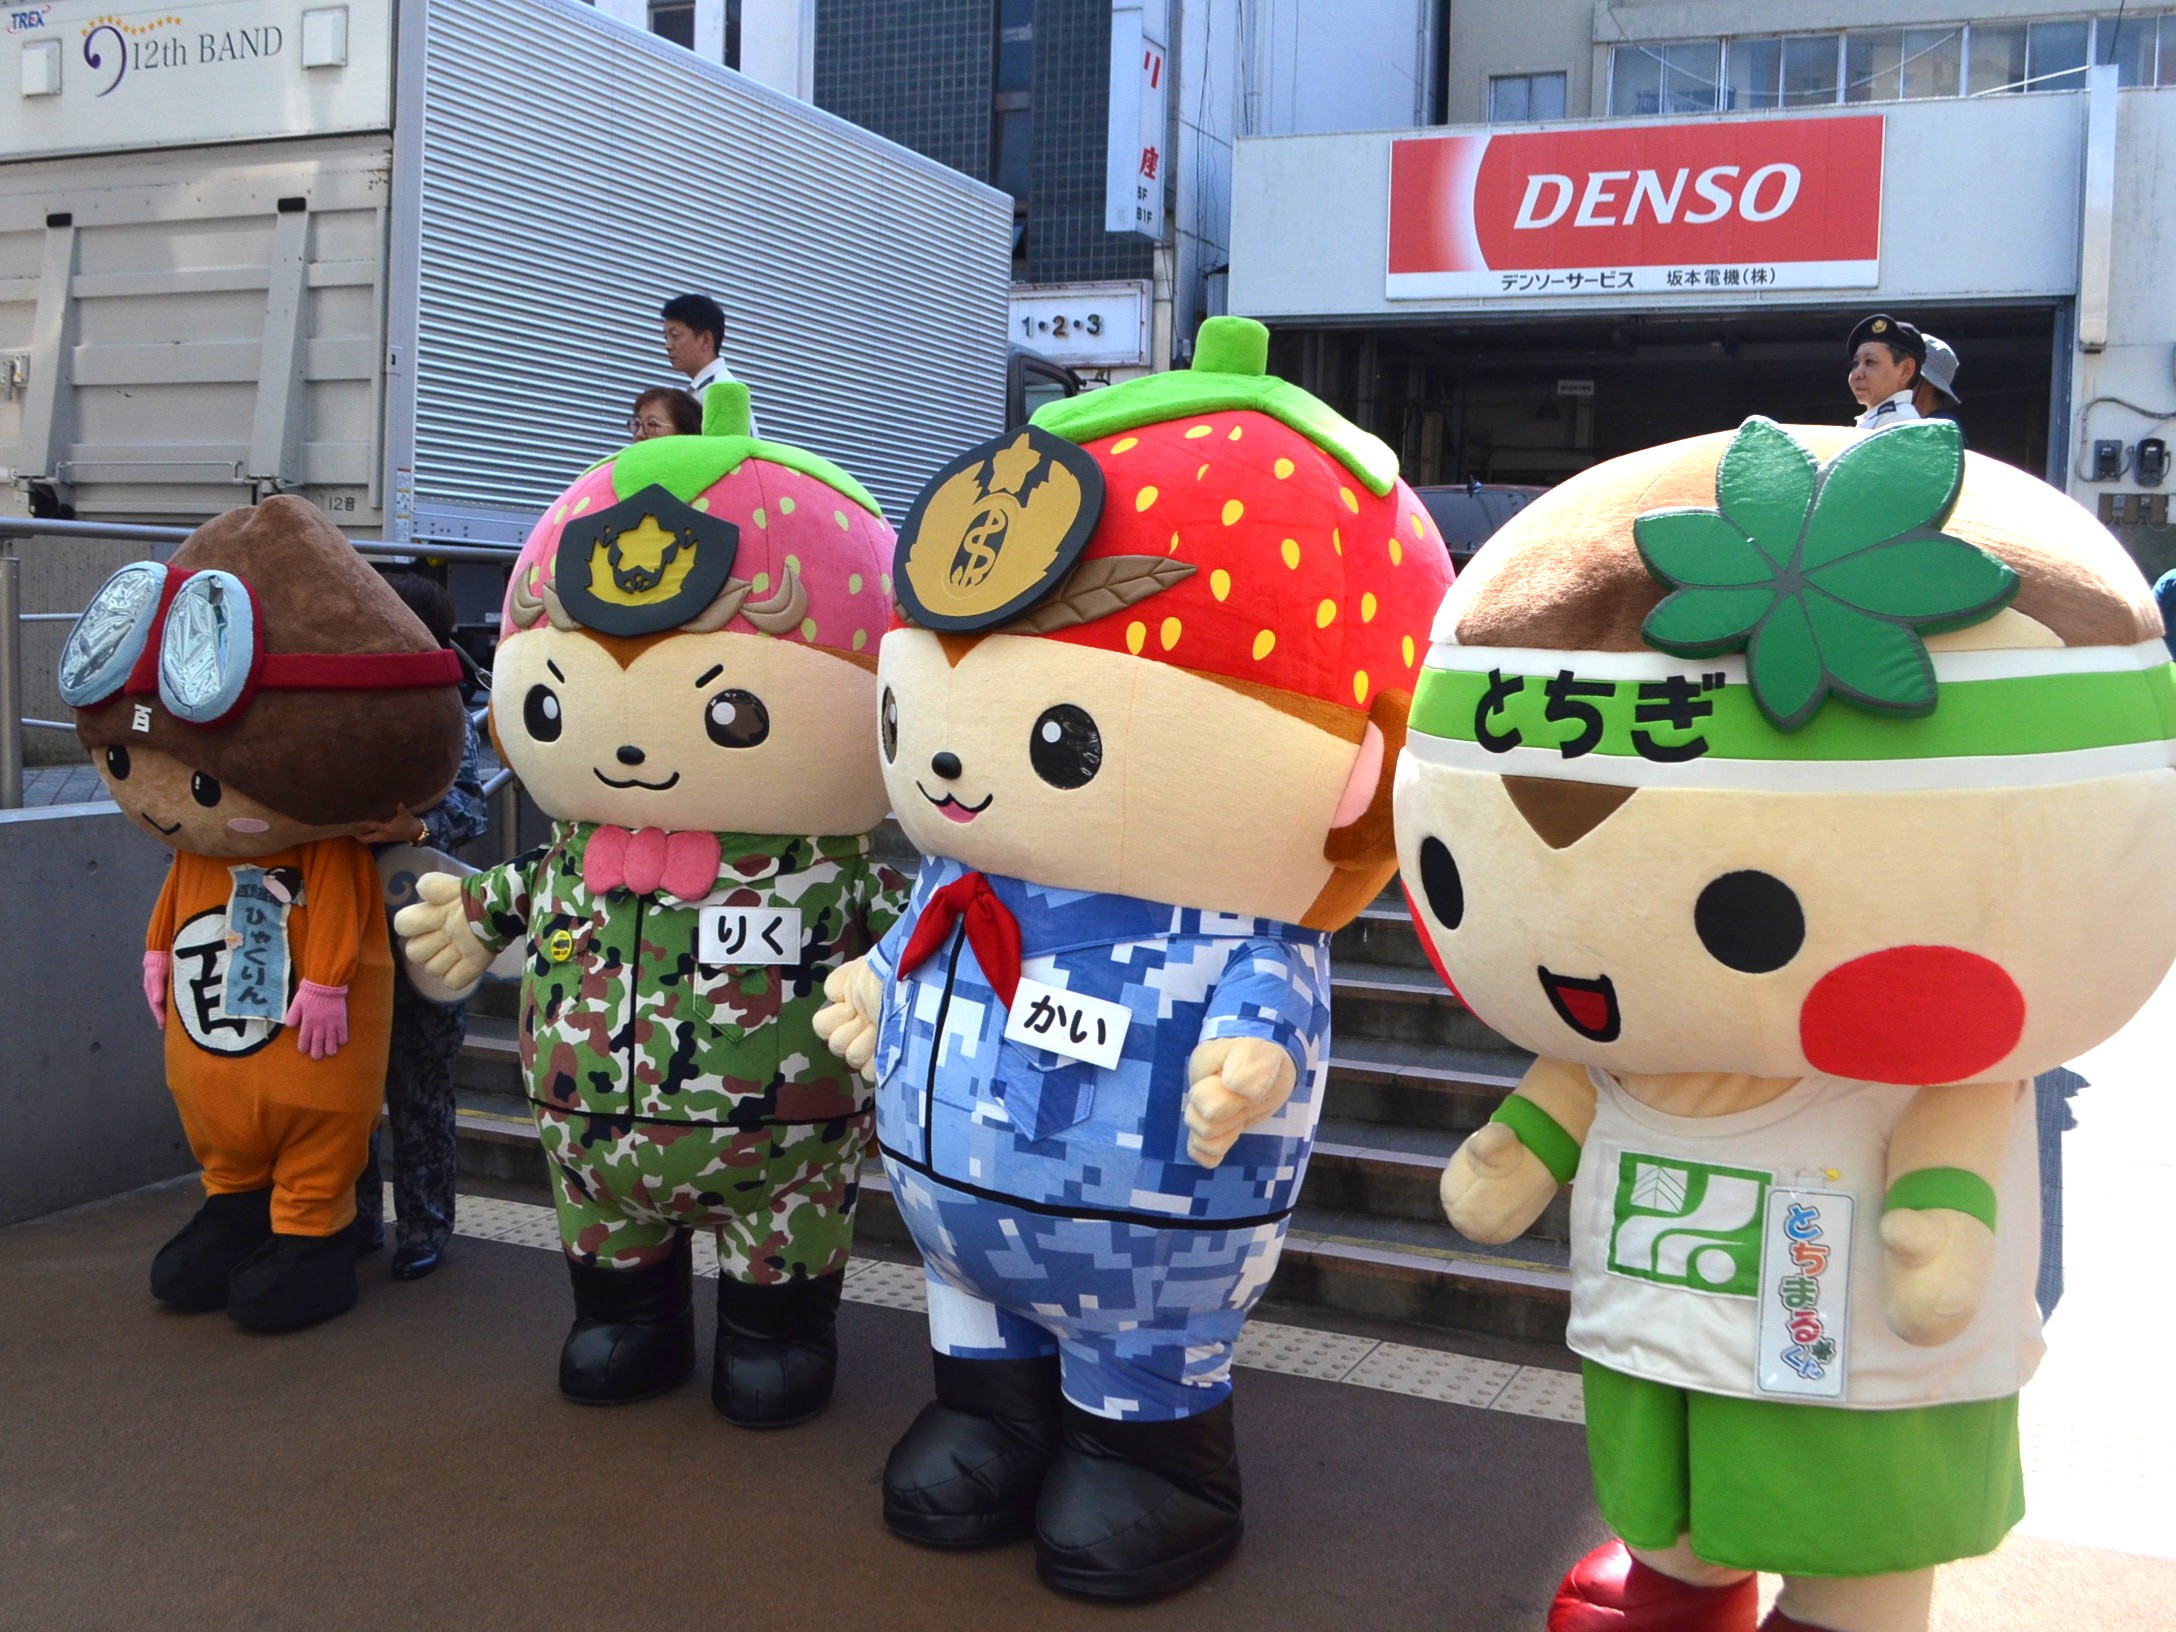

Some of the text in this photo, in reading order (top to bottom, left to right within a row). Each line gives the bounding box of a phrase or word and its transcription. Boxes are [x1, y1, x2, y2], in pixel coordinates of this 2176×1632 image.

[11, 10, 45, 30] TREX
[132, 25, 283, 71] 12th BAND
[1513, 163, 1802, 230] DENSO
[1501, 271, 1635, 291] デンソーサービス
[328, 496, 356, 512] 12音
[1474, 668, 1726, 763] とちぎ
[236, 906, 272, 1006] ひゃくりん
[716, 913, 784, 955] りく
[1023, 994, 1106, 1046] かい
[1778, 1202, 1832, 1381] とちまるくん
